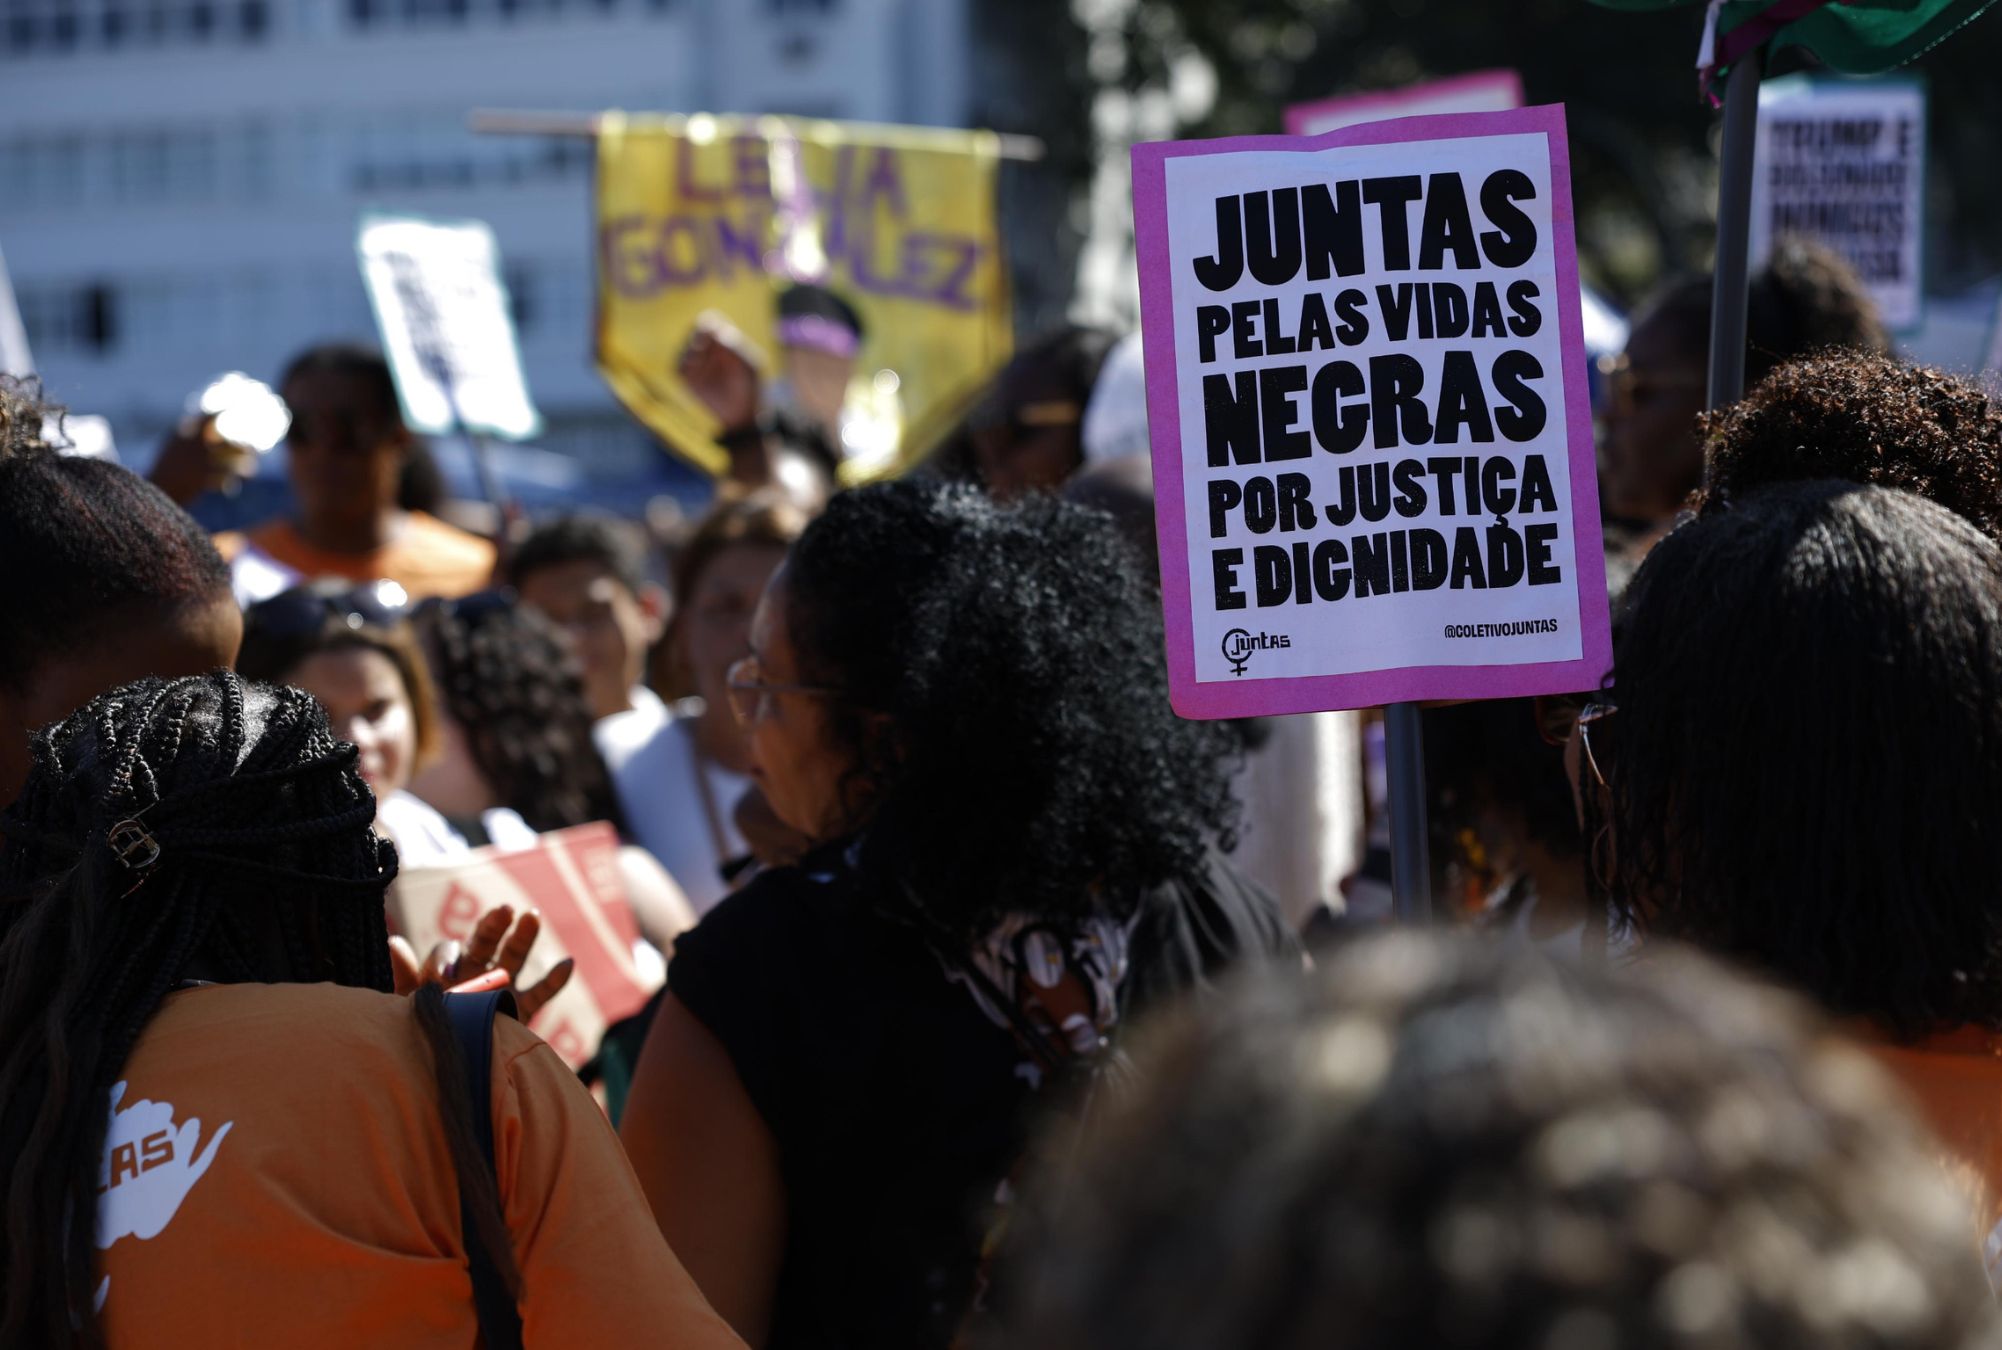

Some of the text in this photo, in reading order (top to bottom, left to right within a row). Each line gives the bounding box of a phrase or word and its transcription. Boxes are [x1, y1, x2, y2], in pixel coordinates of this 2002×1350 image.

[1193, 168, 1538, 292] JUNTAS
[1197, 280, 1543, 363] PELAS VIDAS
[1203, 350, 1547, 467] NEGRAS
[1208, 454, 1559, 538] POR JUSTIÇA
[1212, 523, 1562, 611] E DIGNIDADE
[1444, 618, 1558, 639] @COLETIVOJUNTAS
